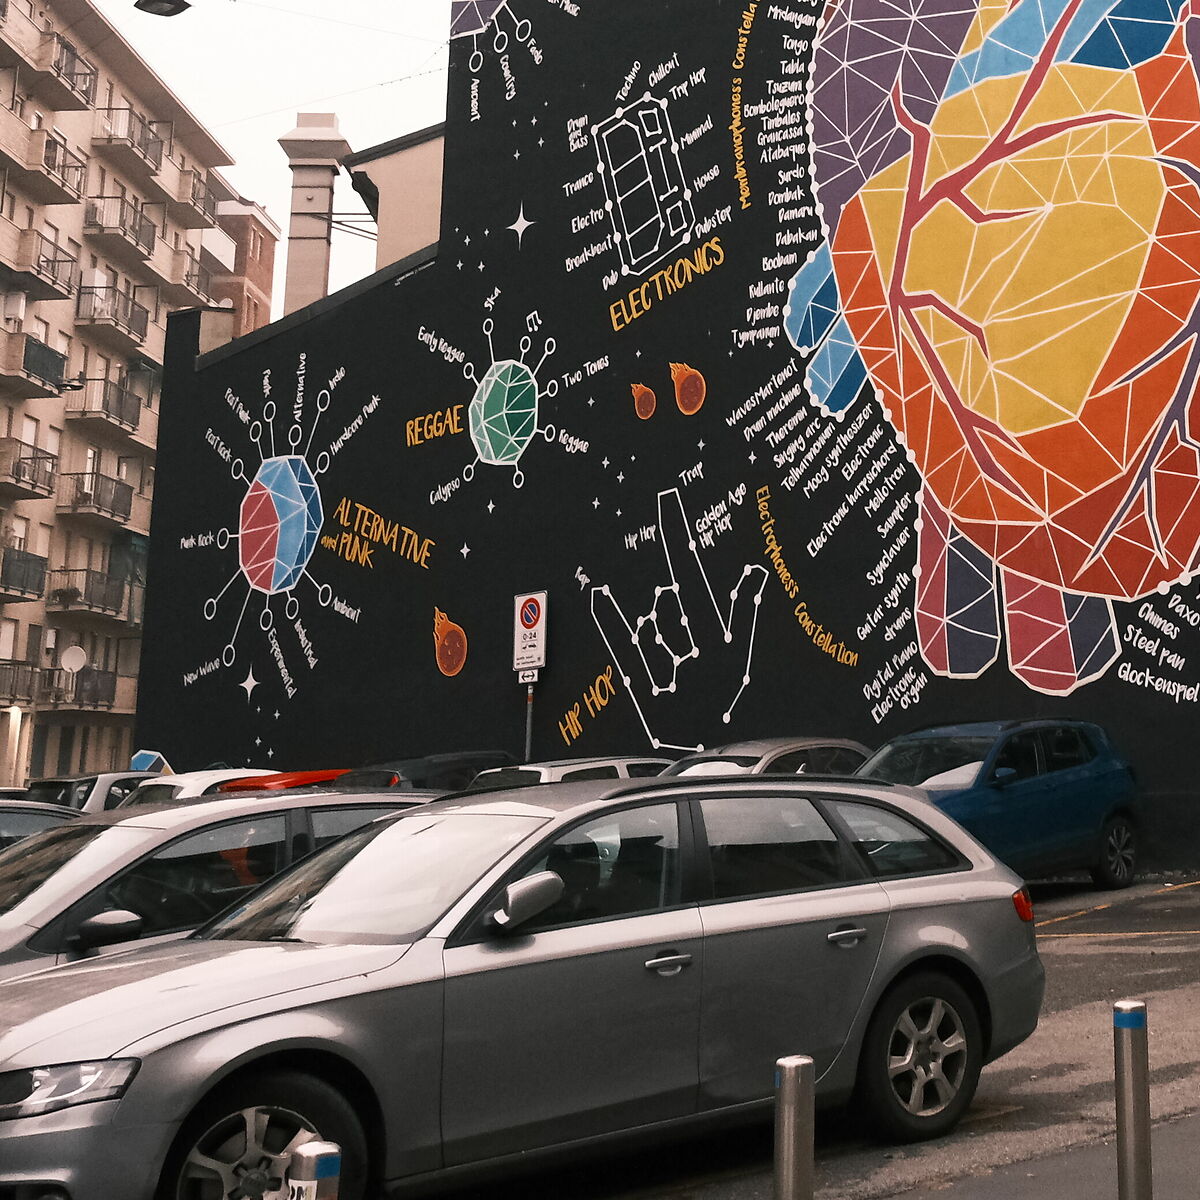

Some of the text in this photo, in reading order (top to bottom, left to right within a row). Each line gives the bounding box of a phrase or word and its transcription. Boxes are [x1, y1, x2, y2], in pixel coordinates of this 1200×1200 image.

[615, 60, 642, 101] Techno
[648, 52, 681, 88] Chillout
[780, 58, 805, 75] Tabla
[569, 134, 589, 153] Bass
[760, 142, 806, 164] Atabaque
[562, 171, 594, 198] Trance
[693, 164, 721, 193] House
[777, 163, 805, 185] Surdo
[571, 208, 604, 234] Electro
[695, 205, 733, 239] Dubstep
[565, 233, 614, 273] Breakbeat
[609, 236, 726, 332] ELECTRONICS
[746, 302, 779, 326] Djembe
[561, 354, 610, 388] Two Tones
[405, 404, 464, 448] REGGAE
[765, 406, 808, 449] Theremin
[803, 402, 873, 499] Moog synthesizer
[841, 423, 884, 481] Electronic
[429, 477, 461, 506] Calypso
[678, 461, 705, 487] Trap
[864, 462, 907, 518] Mellotron
[695, 482, 748, 533] Golden Age
[806, 439, 898, 558] Electronic harpsichord
[876, 491, 912, 539] Sampler
[321, 532, 375, 569] and PUNK
[333, 496, 436, 570] ALTERNATIVE
[866, 526, 911, 586] Synclavier
[856, 571, 911, 641] Guitar synth
[884, 606, 912, 642] drums
[794, 601, 859, 667] Constellation
[558, 664, 616, 747] HIP HOP
[871, 665, 917, 725] Electronic
[900, 671, 928, 710] organ
